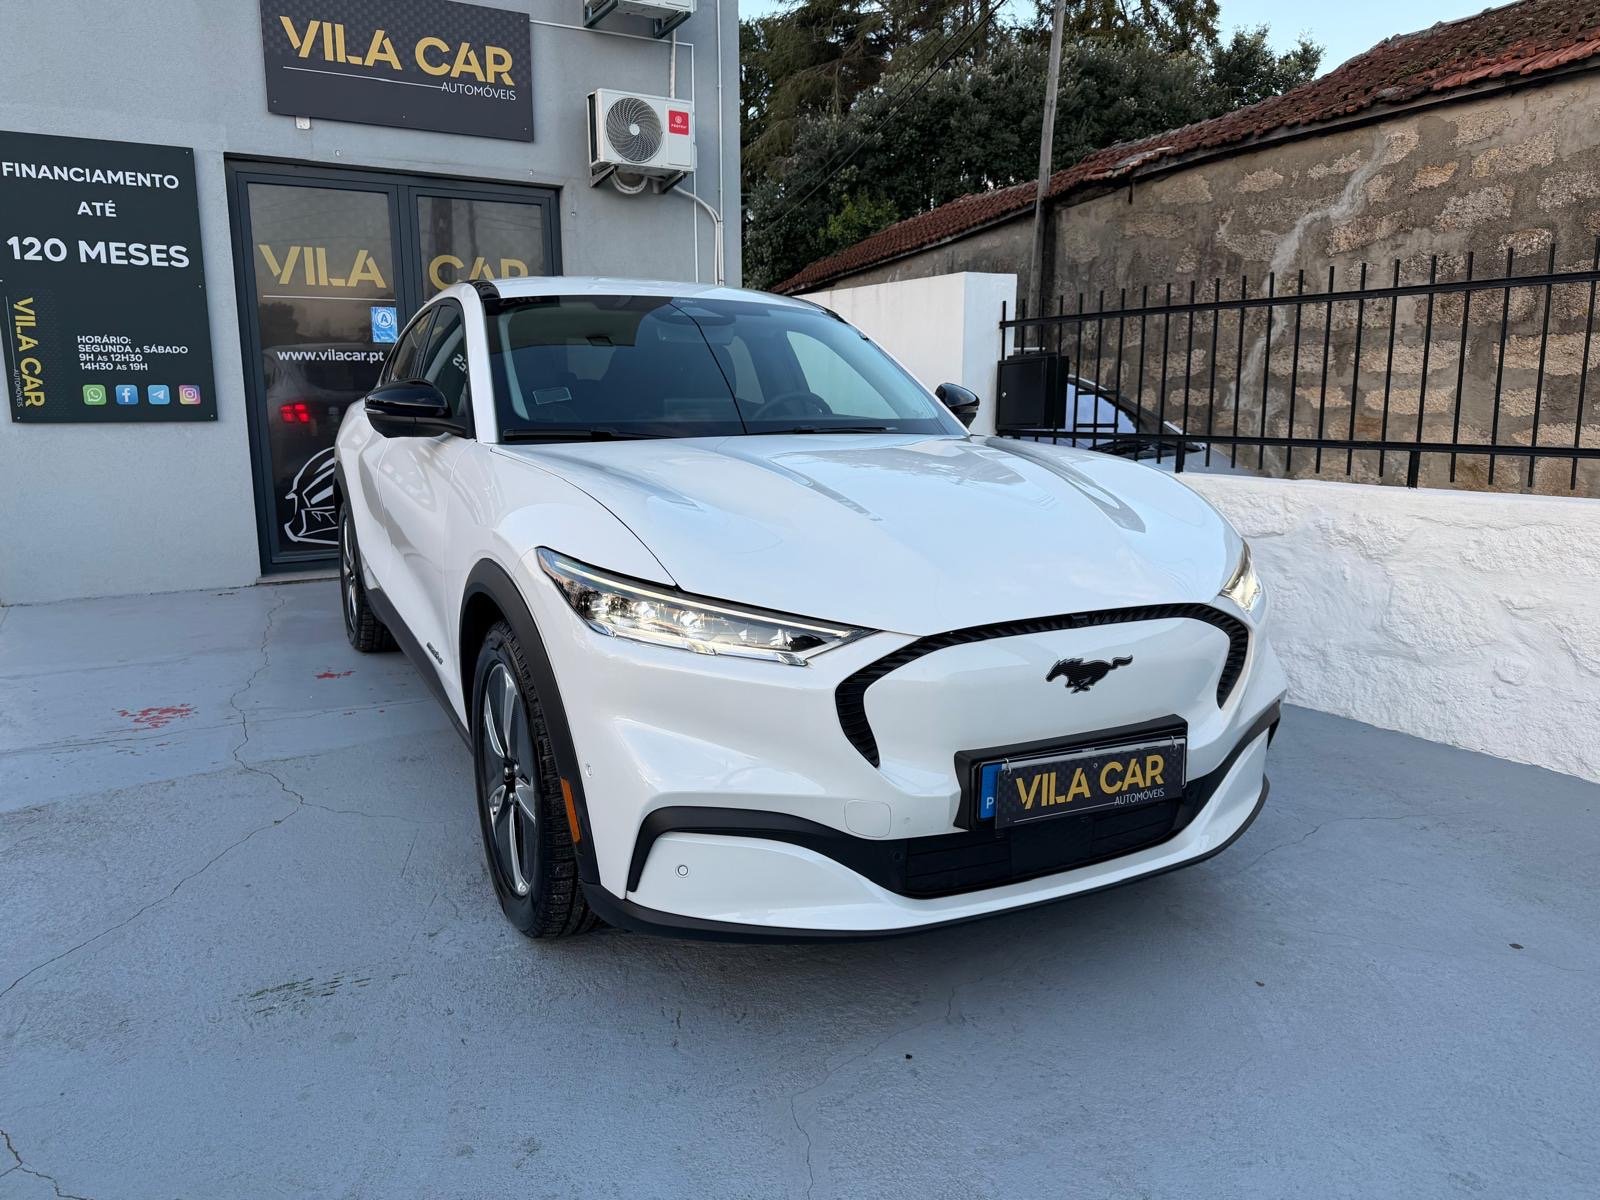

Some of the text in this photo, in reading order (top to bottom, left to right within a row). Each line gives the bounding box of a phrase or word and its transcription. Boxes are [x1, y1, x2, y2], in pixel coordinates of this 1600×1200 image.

[279, 16, 515, 86] VILA CAR
[441, 82, 516, 101] AUTOMÓVEIS
[1, 161, 179, 189] FINANCIAMENTO
[77, 200, 117, 217] ATÉ
[6, 236, 190, 268] 120 MESES
[257, 244, 387, 289] VILA
[77, 334, 131, 344] HORÁRIO:
[13, 297, 45, 407] VILA CAR
[78, 344, 132, 353] SEGUNDA
[143, 344, 188, 354] SÁBADO
[79, 353, 94, 361] 9H
[110, 353, 143, 362] 12H30
[277, 349, 384, 364] www.vilacar.pt
[80, 362, 114, 370] 14H30
[129, 362, 148, 371] 19H
[1015, 754, 1165, 810] VILA CAR
[986, 796, 994, 809] P
[1114, 788, 1165, 806] AUTOMÓVEIS
